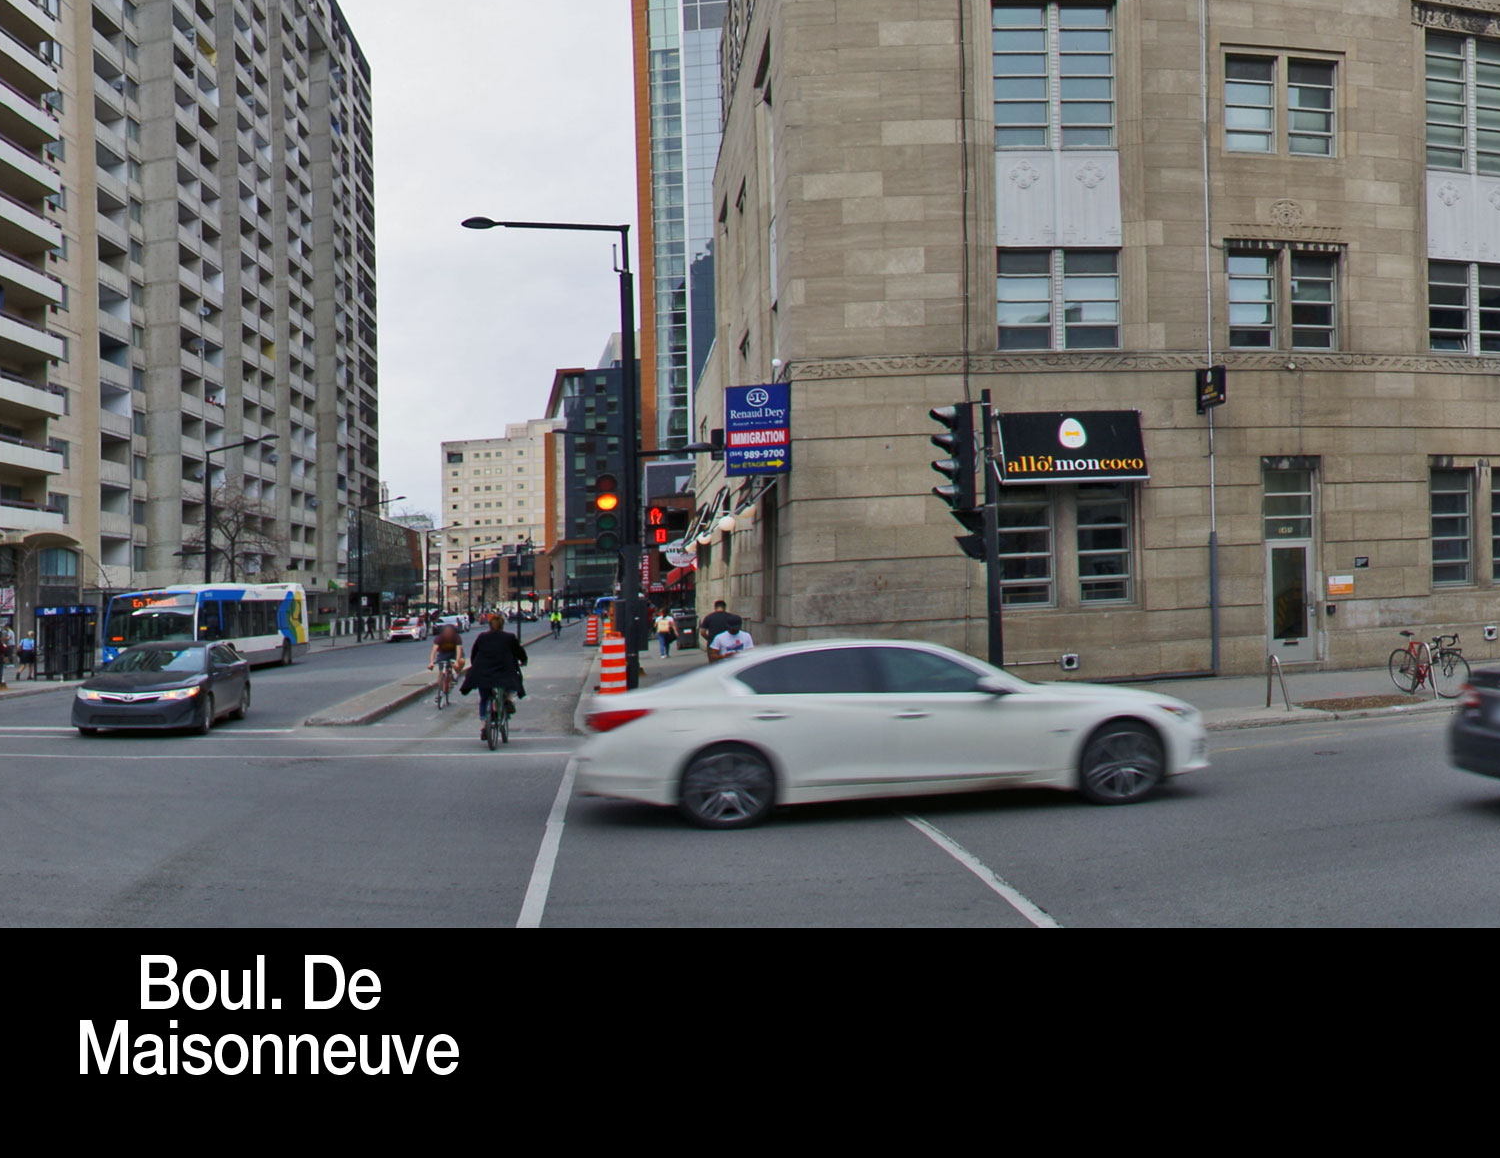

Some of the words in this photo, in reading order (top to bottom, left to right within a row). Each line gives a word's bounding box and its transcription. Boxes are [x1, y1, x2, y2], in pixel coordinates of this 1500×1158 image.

[730, 408, 763, 419] Renaud
[765, 407, 786, 418] Dery
[730, 430, 785, 445] IMMIGRATION
[743, 448, 785, 459] 989-9700
